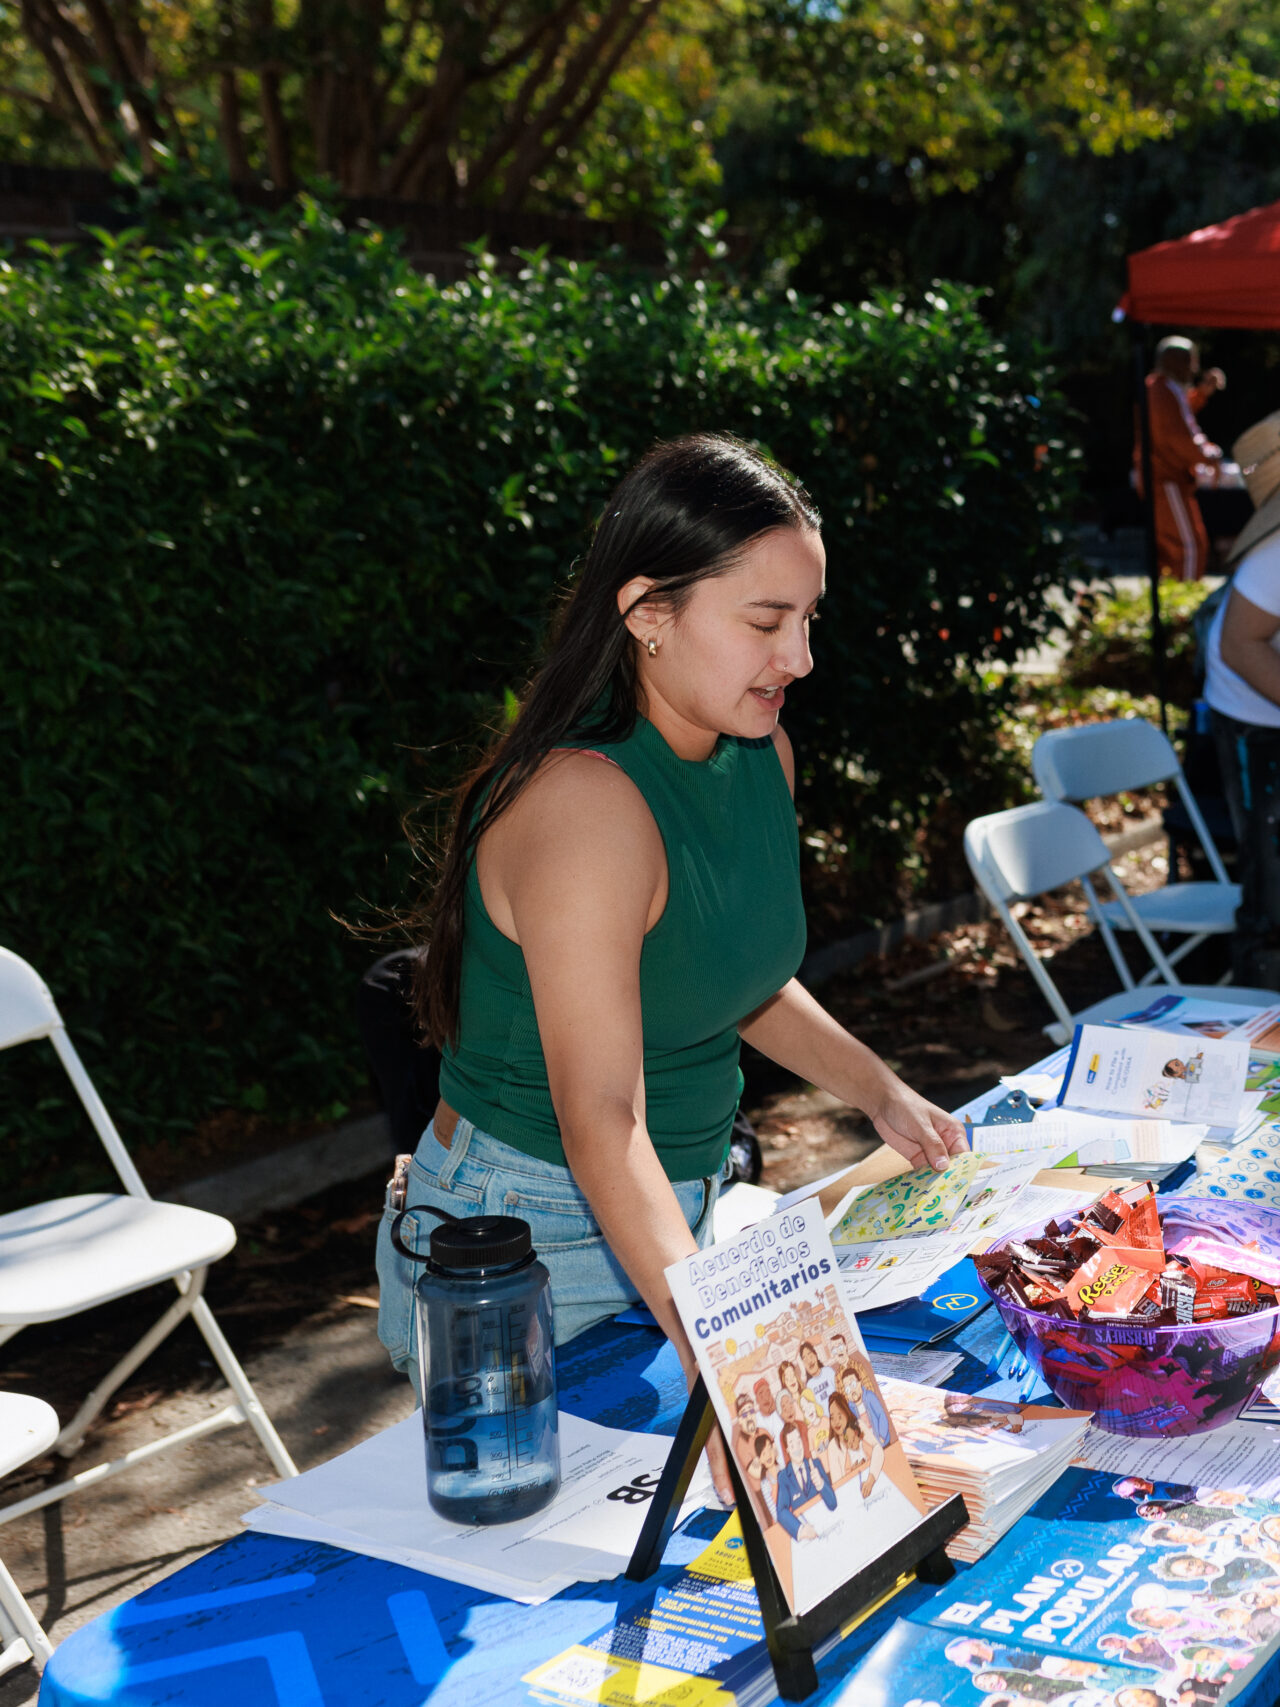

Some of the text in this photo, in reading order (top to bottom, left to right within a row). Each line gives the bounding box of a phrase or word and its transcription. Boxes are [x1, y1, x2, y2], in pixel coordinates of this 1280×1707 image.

[688, 1215, 806, 1286] Acuerdo de
[698, 1241, 811, 1309] Beneficios
[694, 1258, 831, 1339] Comunitarios
[1078, 1264, 1129, 1305] Reese's
[1095, 1328, 1156, 1346] HERSHEY'S
[939, 1600, 992, 1625] EL
[980, 1576, 1064, 1634] PLAN
[1022, 1543, 1146, 1643] POPULAR
